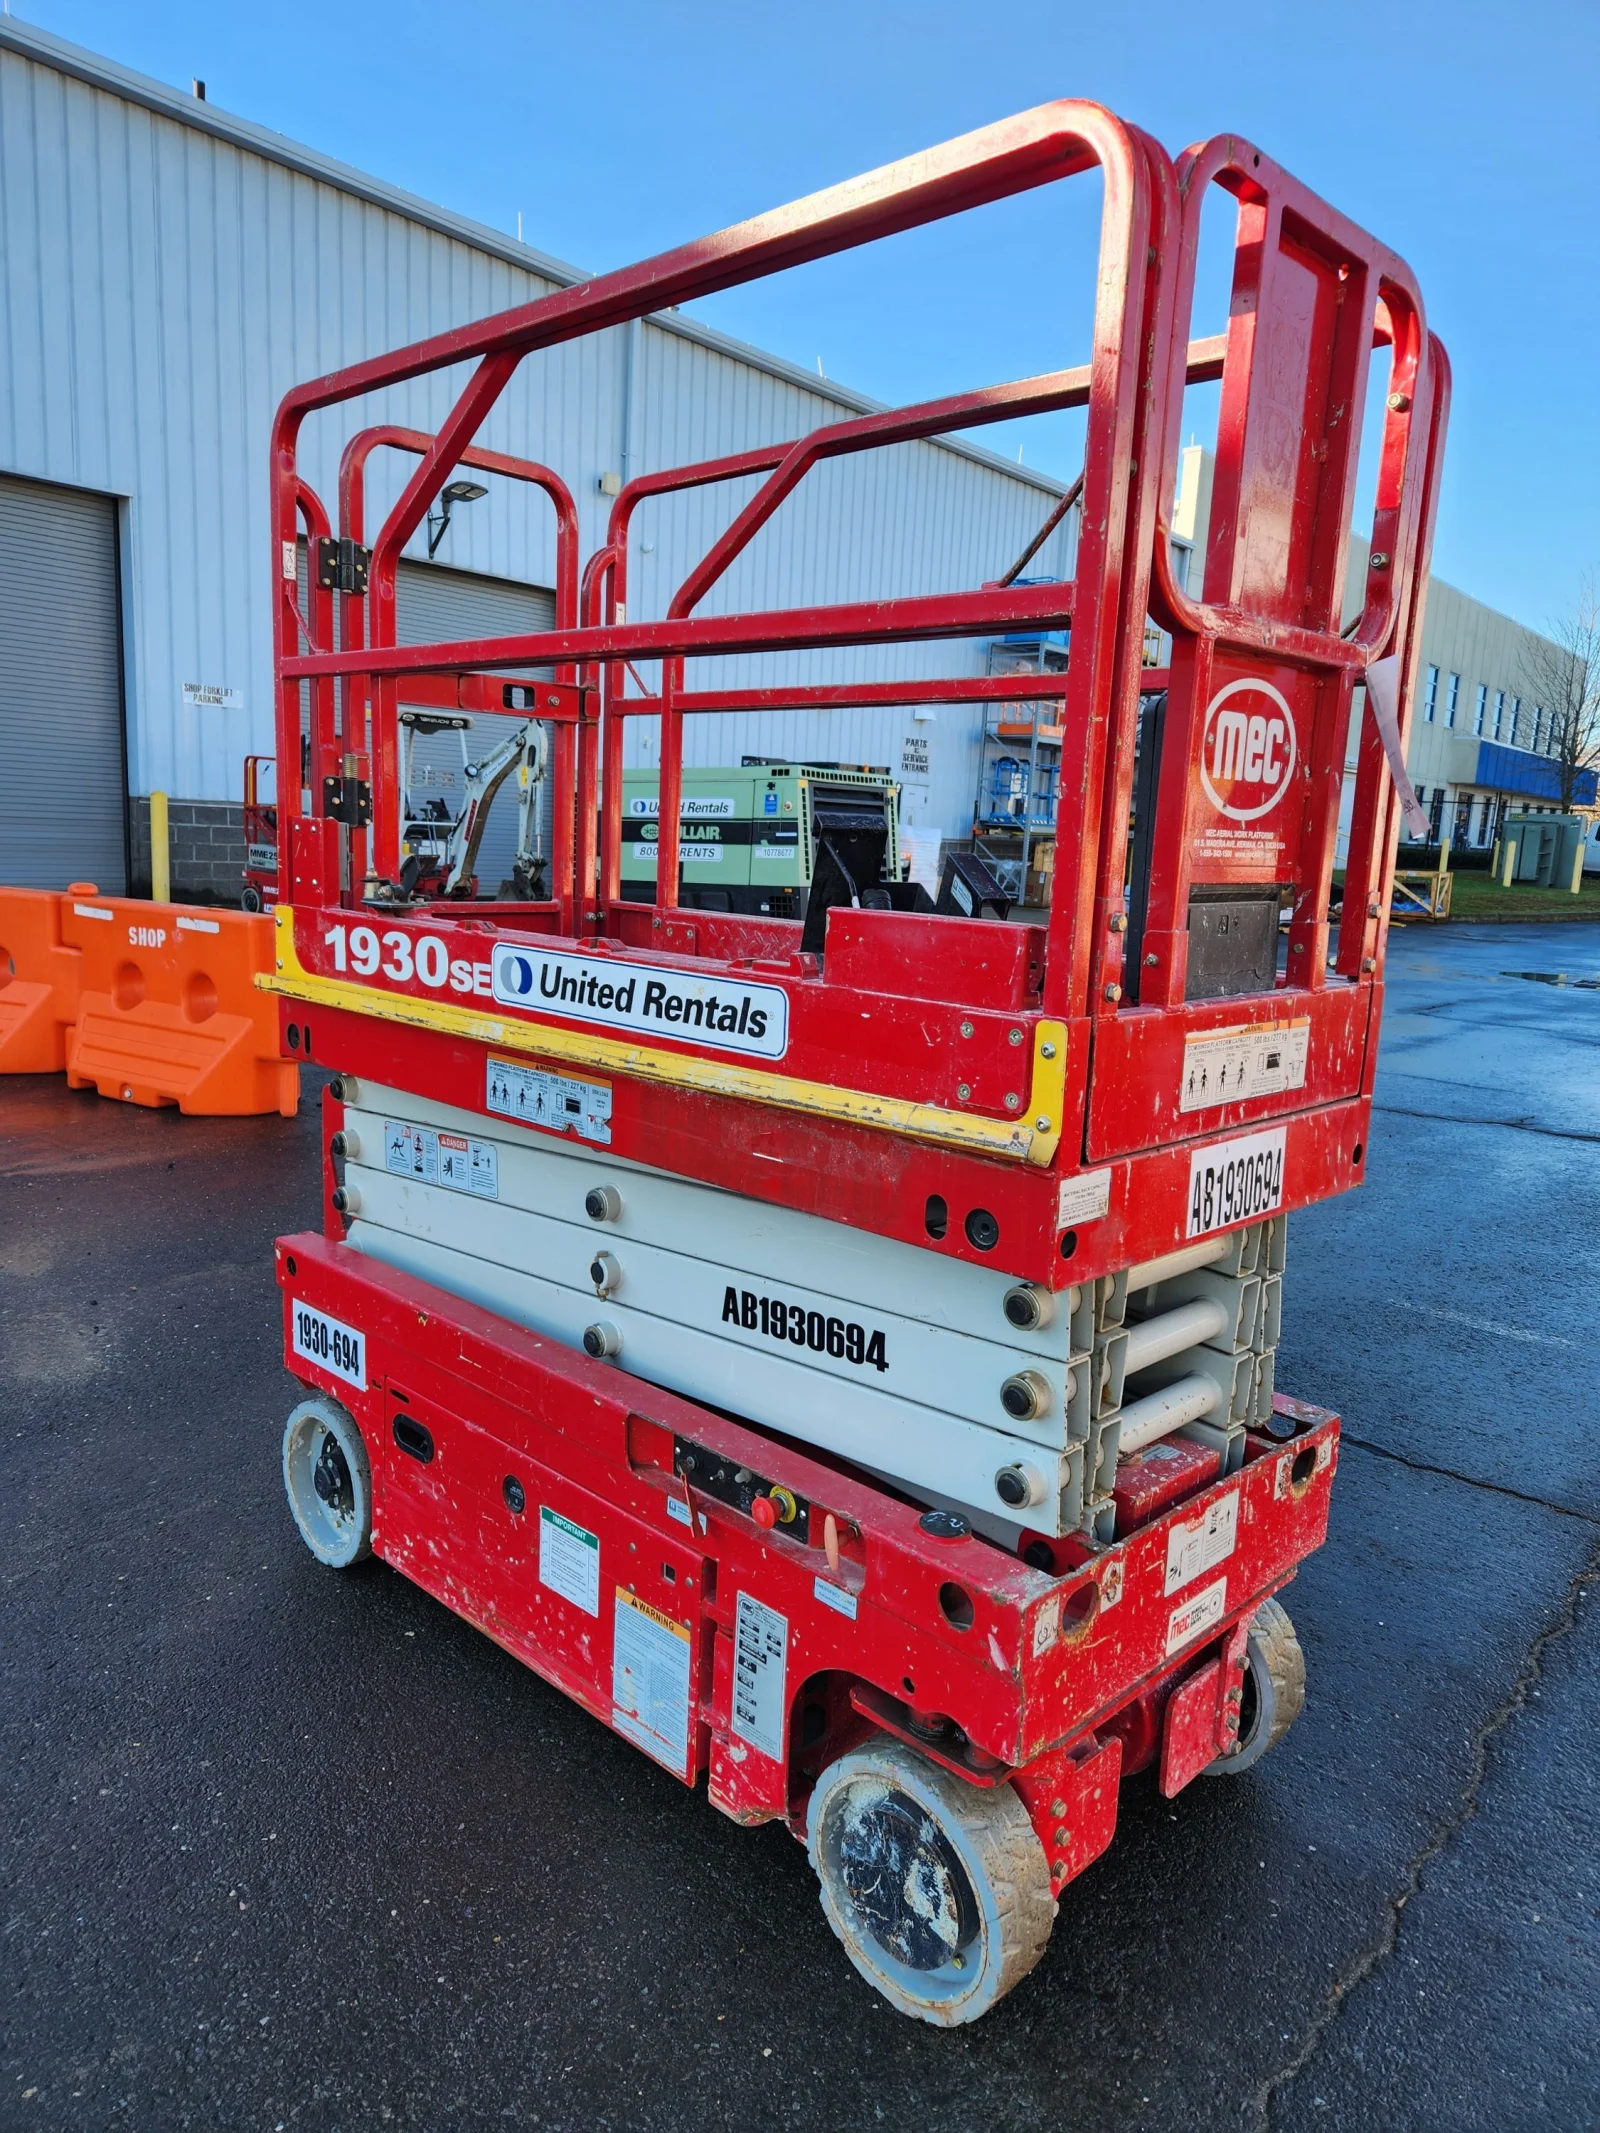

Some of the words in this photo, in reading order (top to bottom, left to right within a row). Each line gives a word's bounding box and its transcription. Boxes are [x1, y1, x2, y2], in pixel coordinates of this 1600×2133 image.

[184, 683, 202, 693] SHOP
[204, 685, 233, 697] FORKLIFT
[193, 693, 223, 705] PARKING
[905, 737, 928, 748] PARTS
[902, 753, 928, 764] SERVICE
[901, 762, 929, 774] ENTRANCE
[687, 802, 729, 814] Rentals
[129, 926, 166, 948] SHOP
[540, 964, 636, 1014] United
[643, 981, 768, 1038] Rentals
[540, 1065, 558, 1075] WARNING
[446, 1138, 467, 1150] DANGER
[1189, 1148, 1282, 1236] AB1930694
[721, 1285, 890, 1373] AB1930694
[297, 1311, 360, 1377] 1930-694
[552, 1514, 587, 1541] IMPORTANT
[638, 1601, 675, 1632] WARNING
